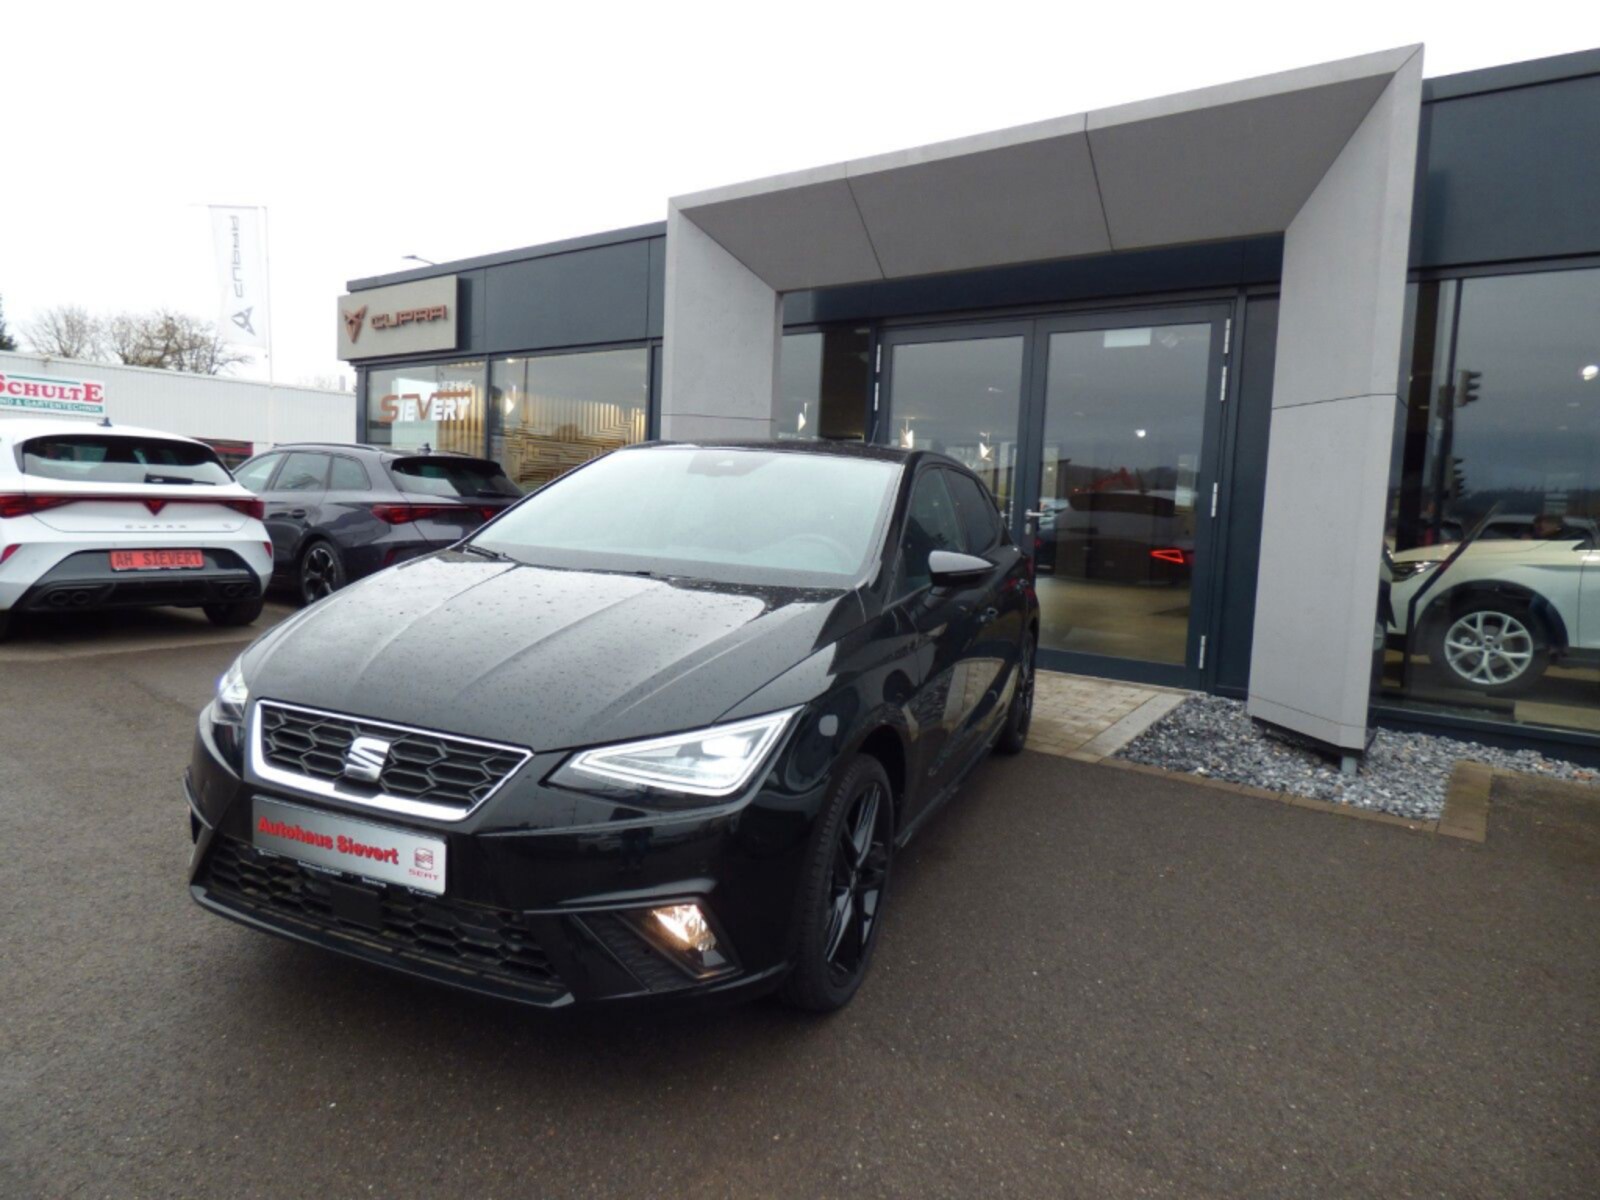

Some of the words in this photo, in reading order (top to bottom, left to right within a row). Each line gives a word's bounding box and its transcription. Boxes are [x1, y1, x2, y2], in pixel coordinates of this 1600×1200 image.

[370, 305, 447, 330] CUPRA
[116, 551, 134, 566] AH
[142, 550, 201, 566] SIEVERT
[257, 816, 334, 850] Autohaus
[336, 834, 399, 866] Sievert
[408, 868, 439, 881] SEAT
